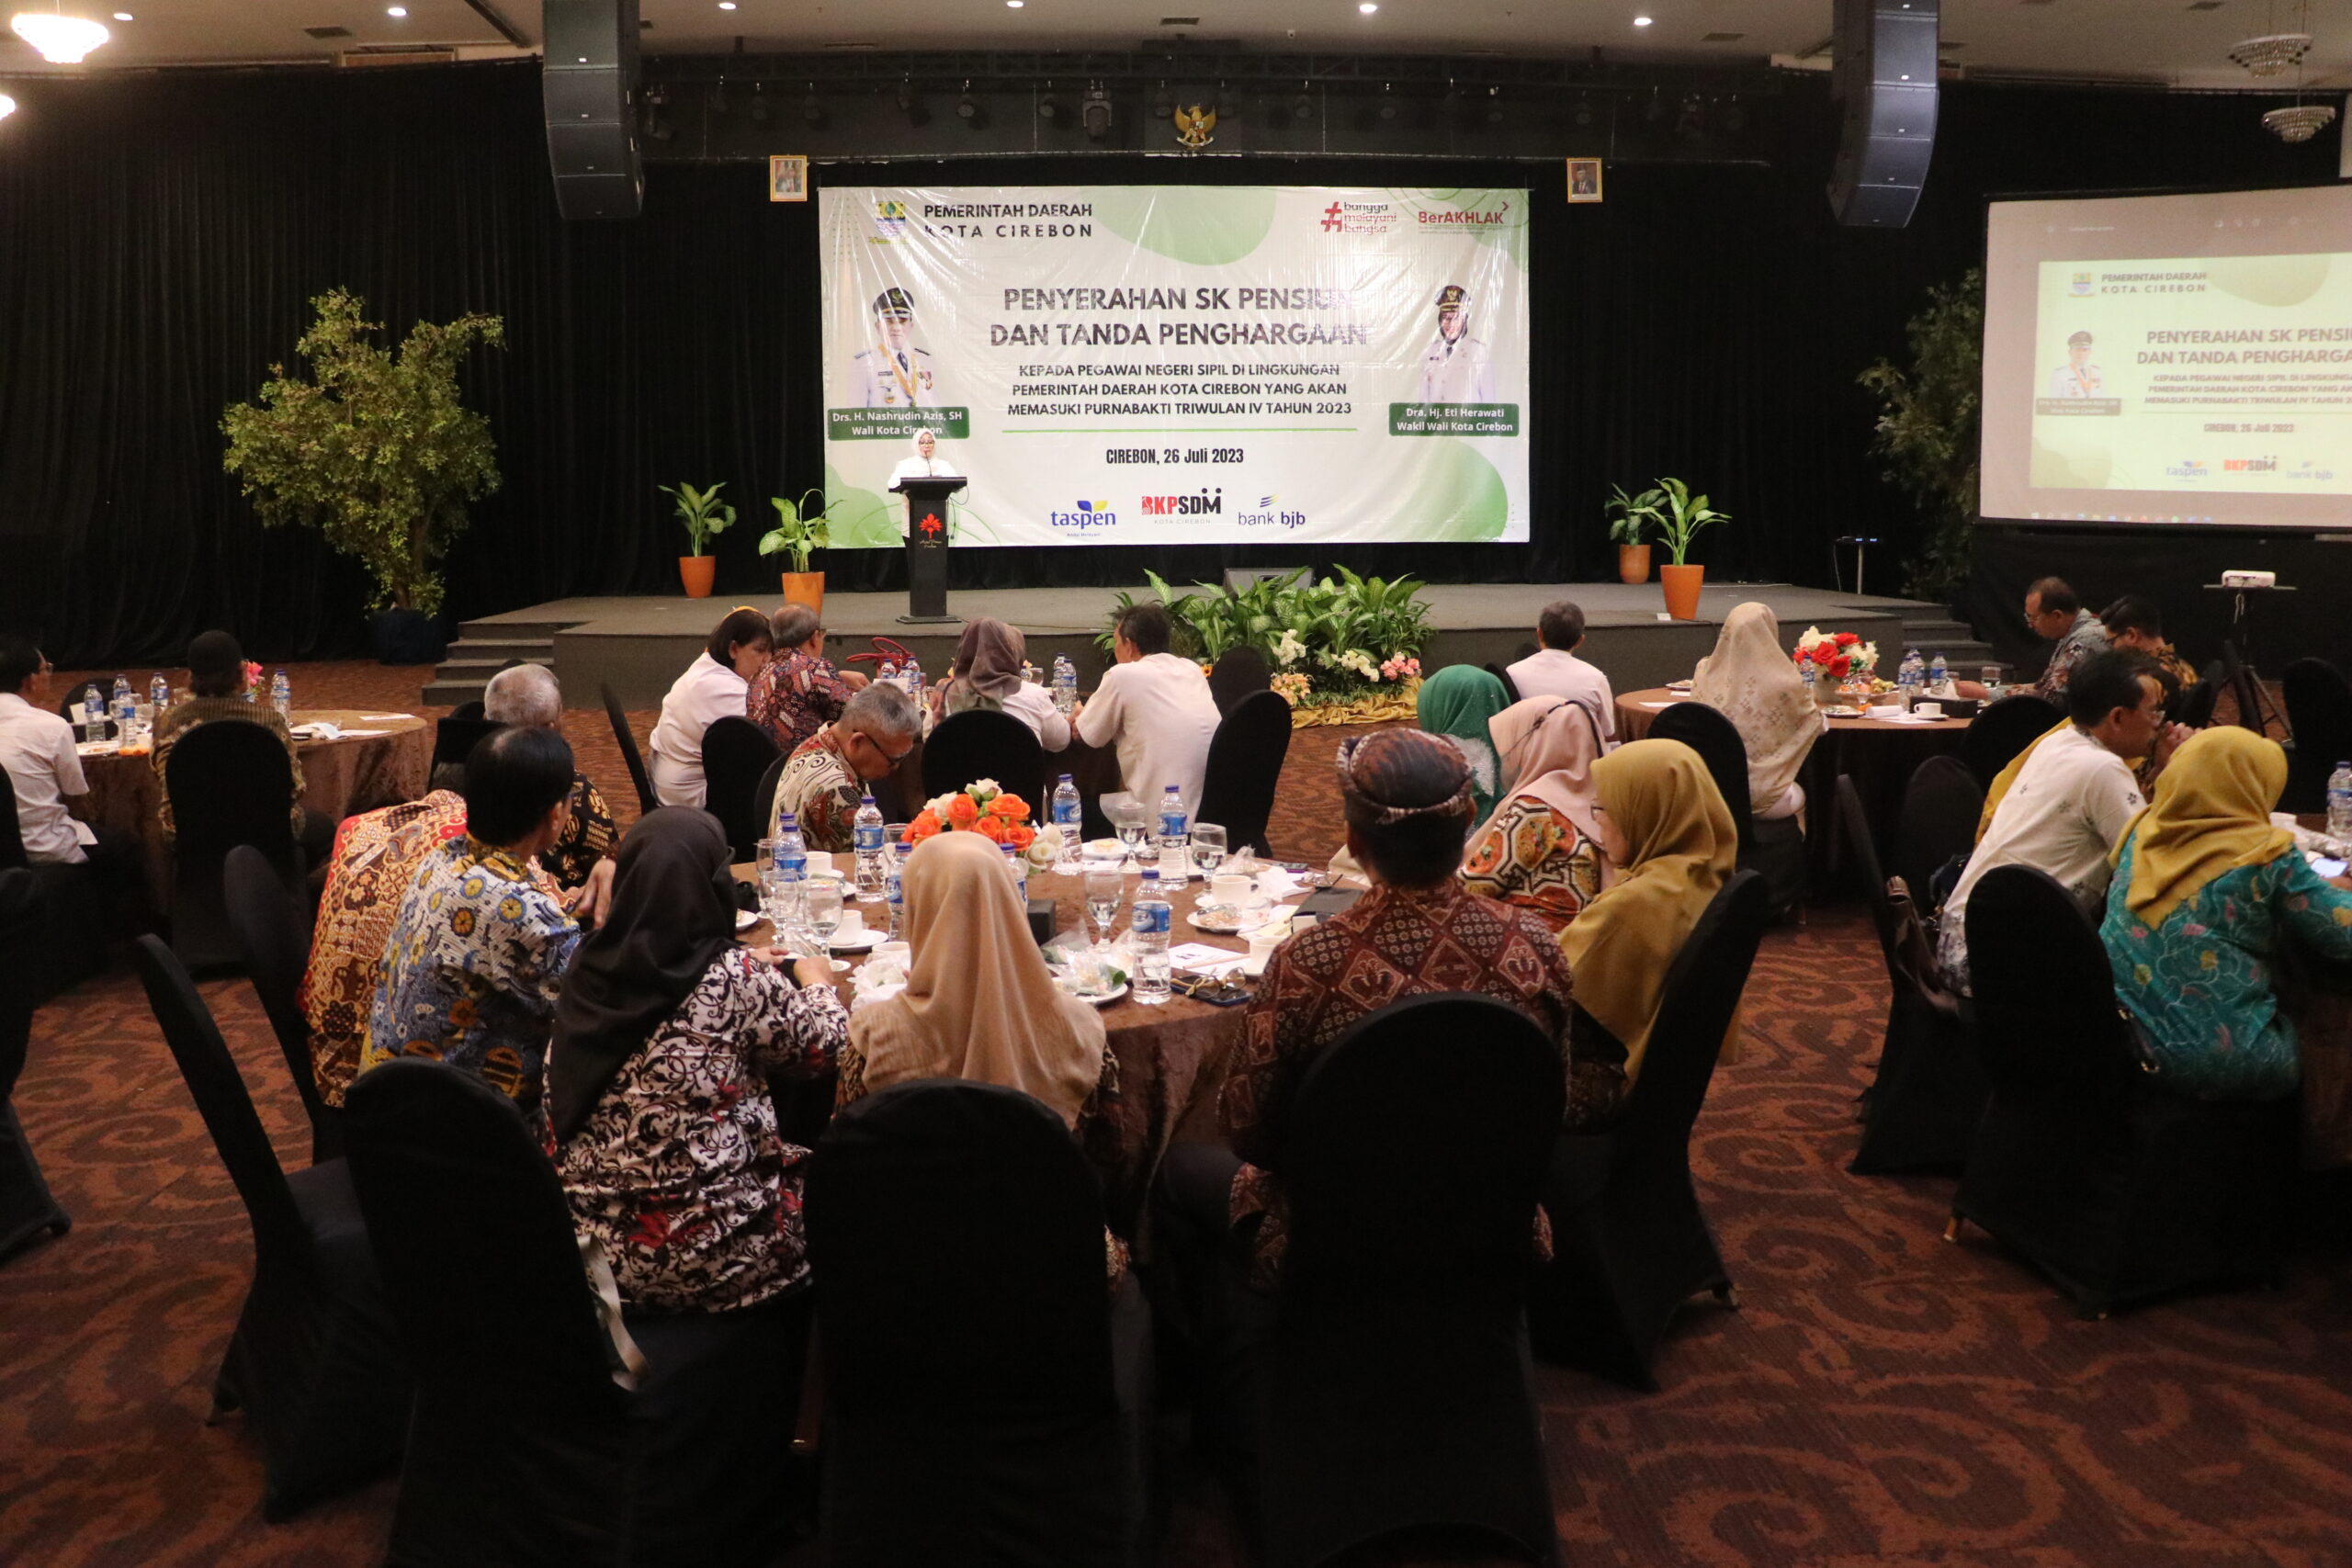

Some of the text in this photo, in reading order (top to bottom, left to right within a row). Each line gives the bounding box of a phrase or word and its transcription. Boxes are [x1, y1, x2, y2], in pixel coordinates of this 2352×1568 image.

[924, 204, 1092, 218] PEMERINTAH DAERAH
[1344, 201, 1388, 214] bangga
[1344, 213, 1396, 224] melayani
[1418, 211, 1504, 224] BerAKHLAK
[924, 224, 1091, 238] KOTA CIREBON
[1344, 223, 1387, 235] bangsa
[2101, 272, 2207, 282] PEMERINTAH DAERAH
[2101, 284, 2206, 294] KOTA CIREBON
[1004, 288, 1186, 310] PENYERAHAN
[1195, 288, 1231, 310] SK
[990, 322, 1367, 346] DAN TANDA PENGHARGAAN
[2146, 327, 2352, 344] PENYERAHAN SK PENSI
[2137, 351, 2174, 365] DAN
[2178, 351, 2238, 365] TANDA
[1019, 364, 1340, 377] KEPADA PEGAWAI NEGERI SIPIL DI LINGKUNGAN
[1012, 383, 1347, 396] PEMERINTAH DAERAH KOTA CIREBON YANG AKAN
[1008, 402, 1351, 415] MEMASUKI PURNABAKTI TRIWULAN IV TAHUN 2023
[1406, 408, 1505, 419] Dra. Hj. Eti Herawati
[832, 411, 962, 422] Drs. H. Nashrudin Azis, SH
[852, 425, 943, 435] Wali Kota Ciron
[1396, 422, 1513, 432] Wakil Wali Kota Cirebon
[1106, 447, 1244, 465] CIREBON, 26 Juli 2023
[2223, 459, 2277, 471] BKPSDM
[2165, 467, 2208, 477] taspen
[2286, 470, 2334, 481] bank bjb
[1141, 495, 1222, 515] BKPSDM
[1051, 511, 1116, 530] taspen
[1238, 511, 1306, 529] bank bjb
